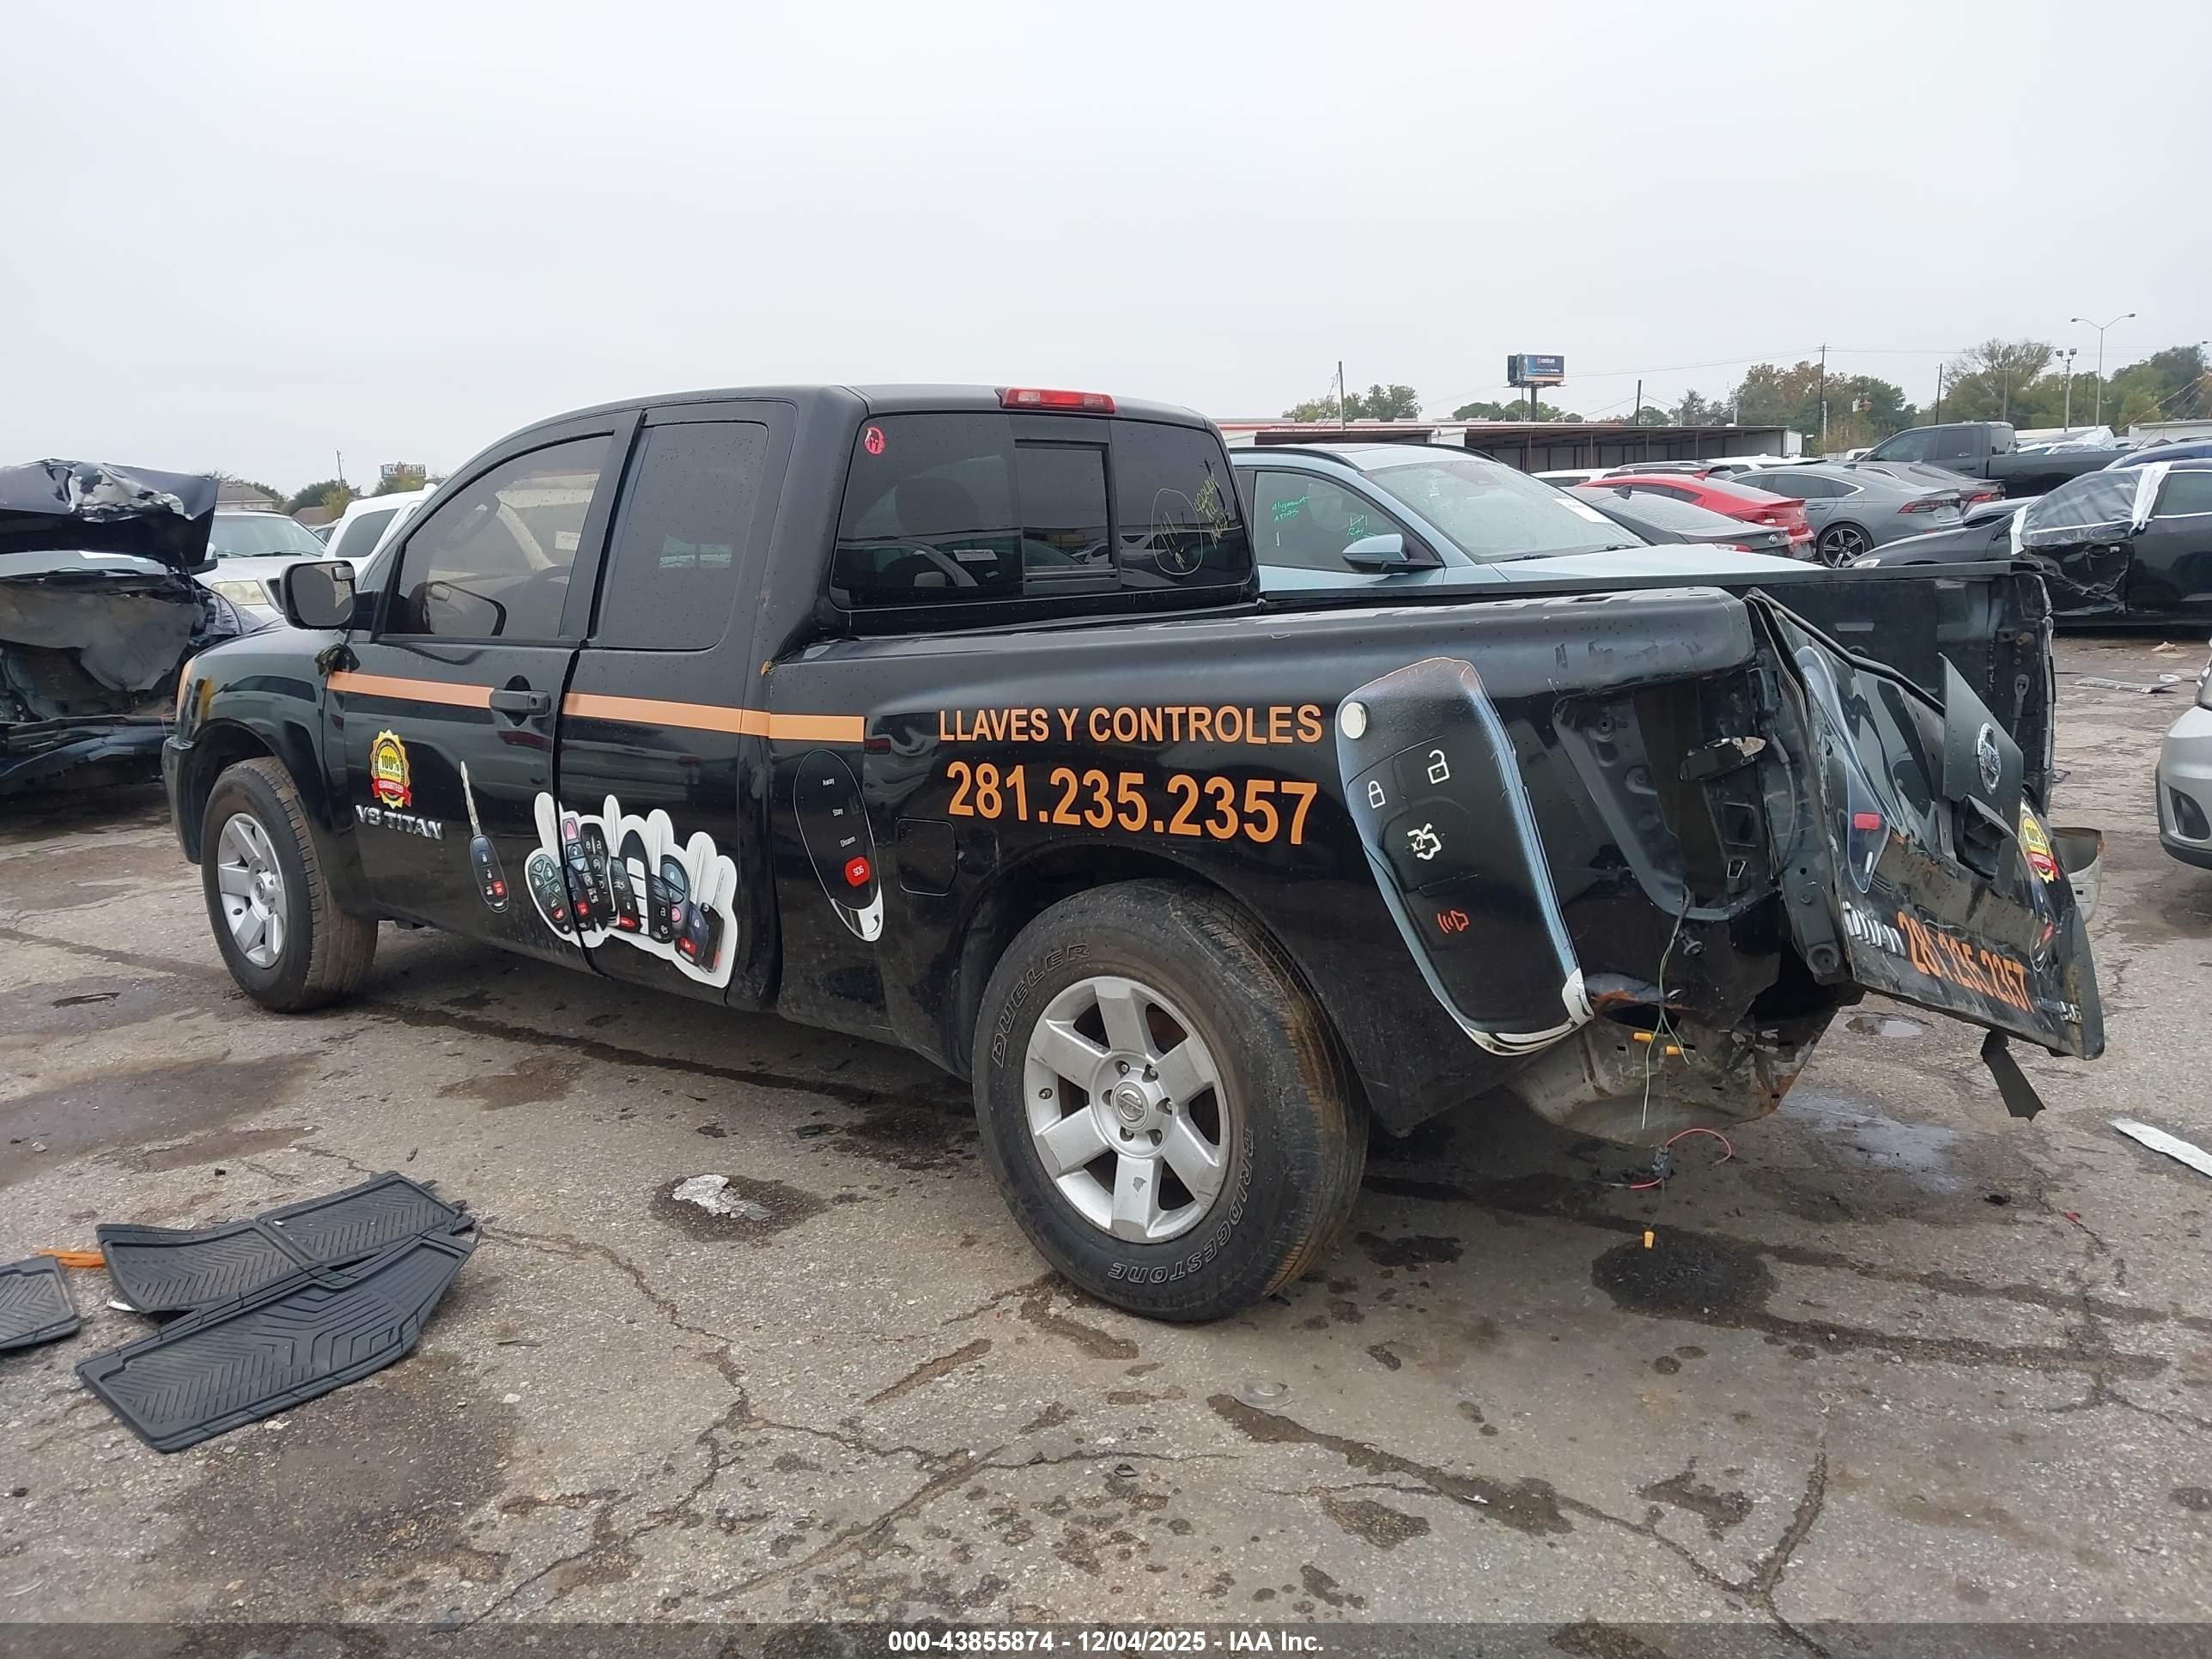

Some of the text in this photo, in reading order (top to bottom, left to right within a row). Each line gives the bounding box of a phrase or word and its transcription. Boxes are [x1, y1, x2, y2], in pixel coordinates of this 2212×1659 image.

[939, 704, 1323, 744] LLAVES Y CONTROLES
[380, 755, 400, 773] 100%
[945, 761, 1319, 846] 281.235.2357
[383, 811, 445, 841] TITAN
[852, 865, 865, 877] SOS
[991, 944, 1091, 1068] DUELER
[1108, 1126, 1255, 1285] BRIDGESTONE
